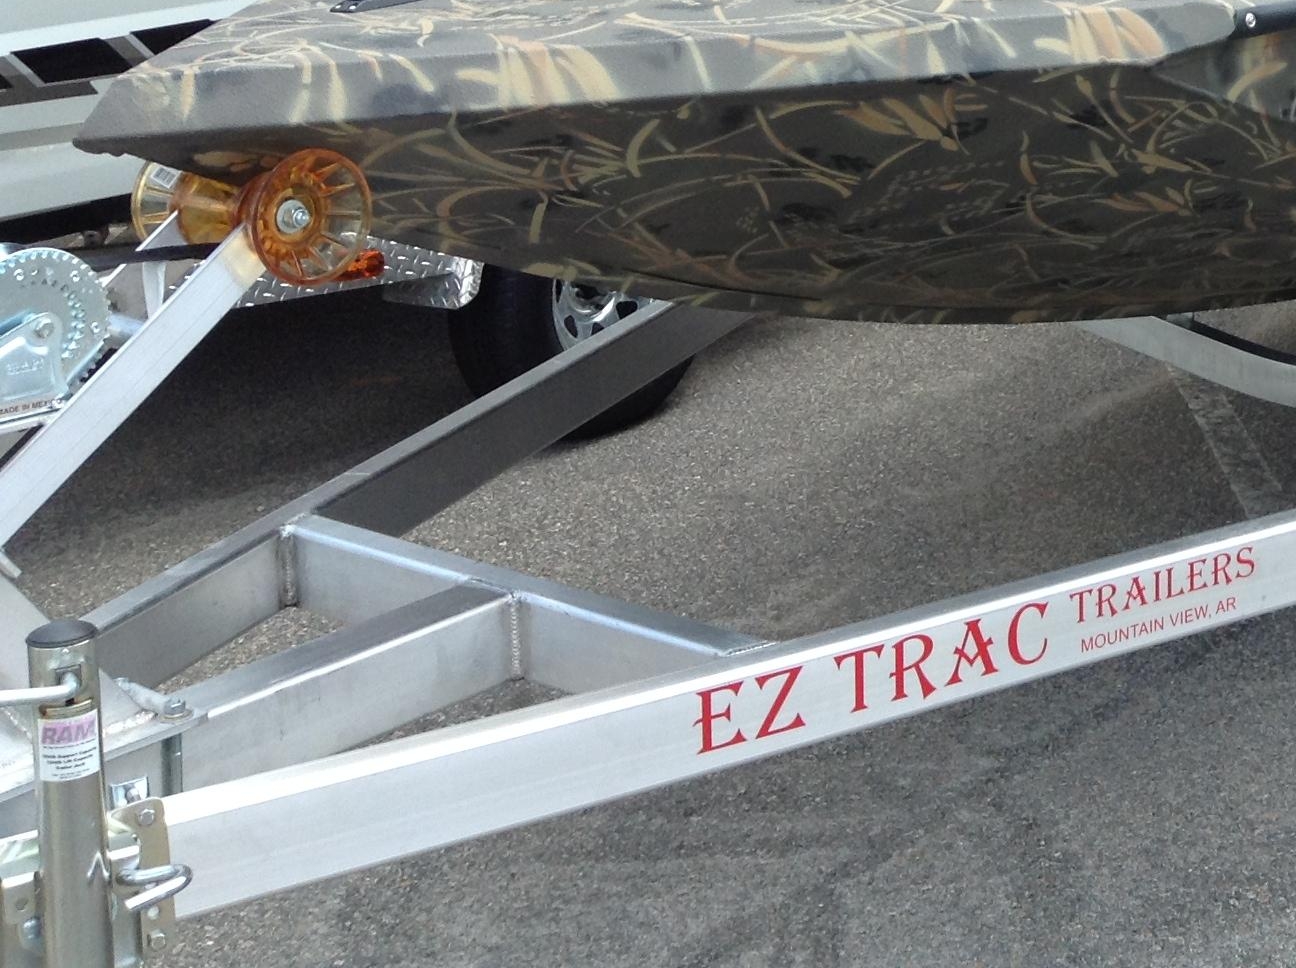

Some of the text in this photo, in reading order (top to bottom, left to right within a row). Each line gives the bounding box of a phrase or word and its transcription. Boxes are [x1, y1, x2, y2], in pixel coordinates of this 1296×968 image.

[1069, 545, 1256, 624] TRAILERS
[1081, 596, 1237, 653] MOUNTAIN VIEW, AR
[693, 600, 1051, 755] EZ TRAC
[41, 719, 97, 744] RAM
